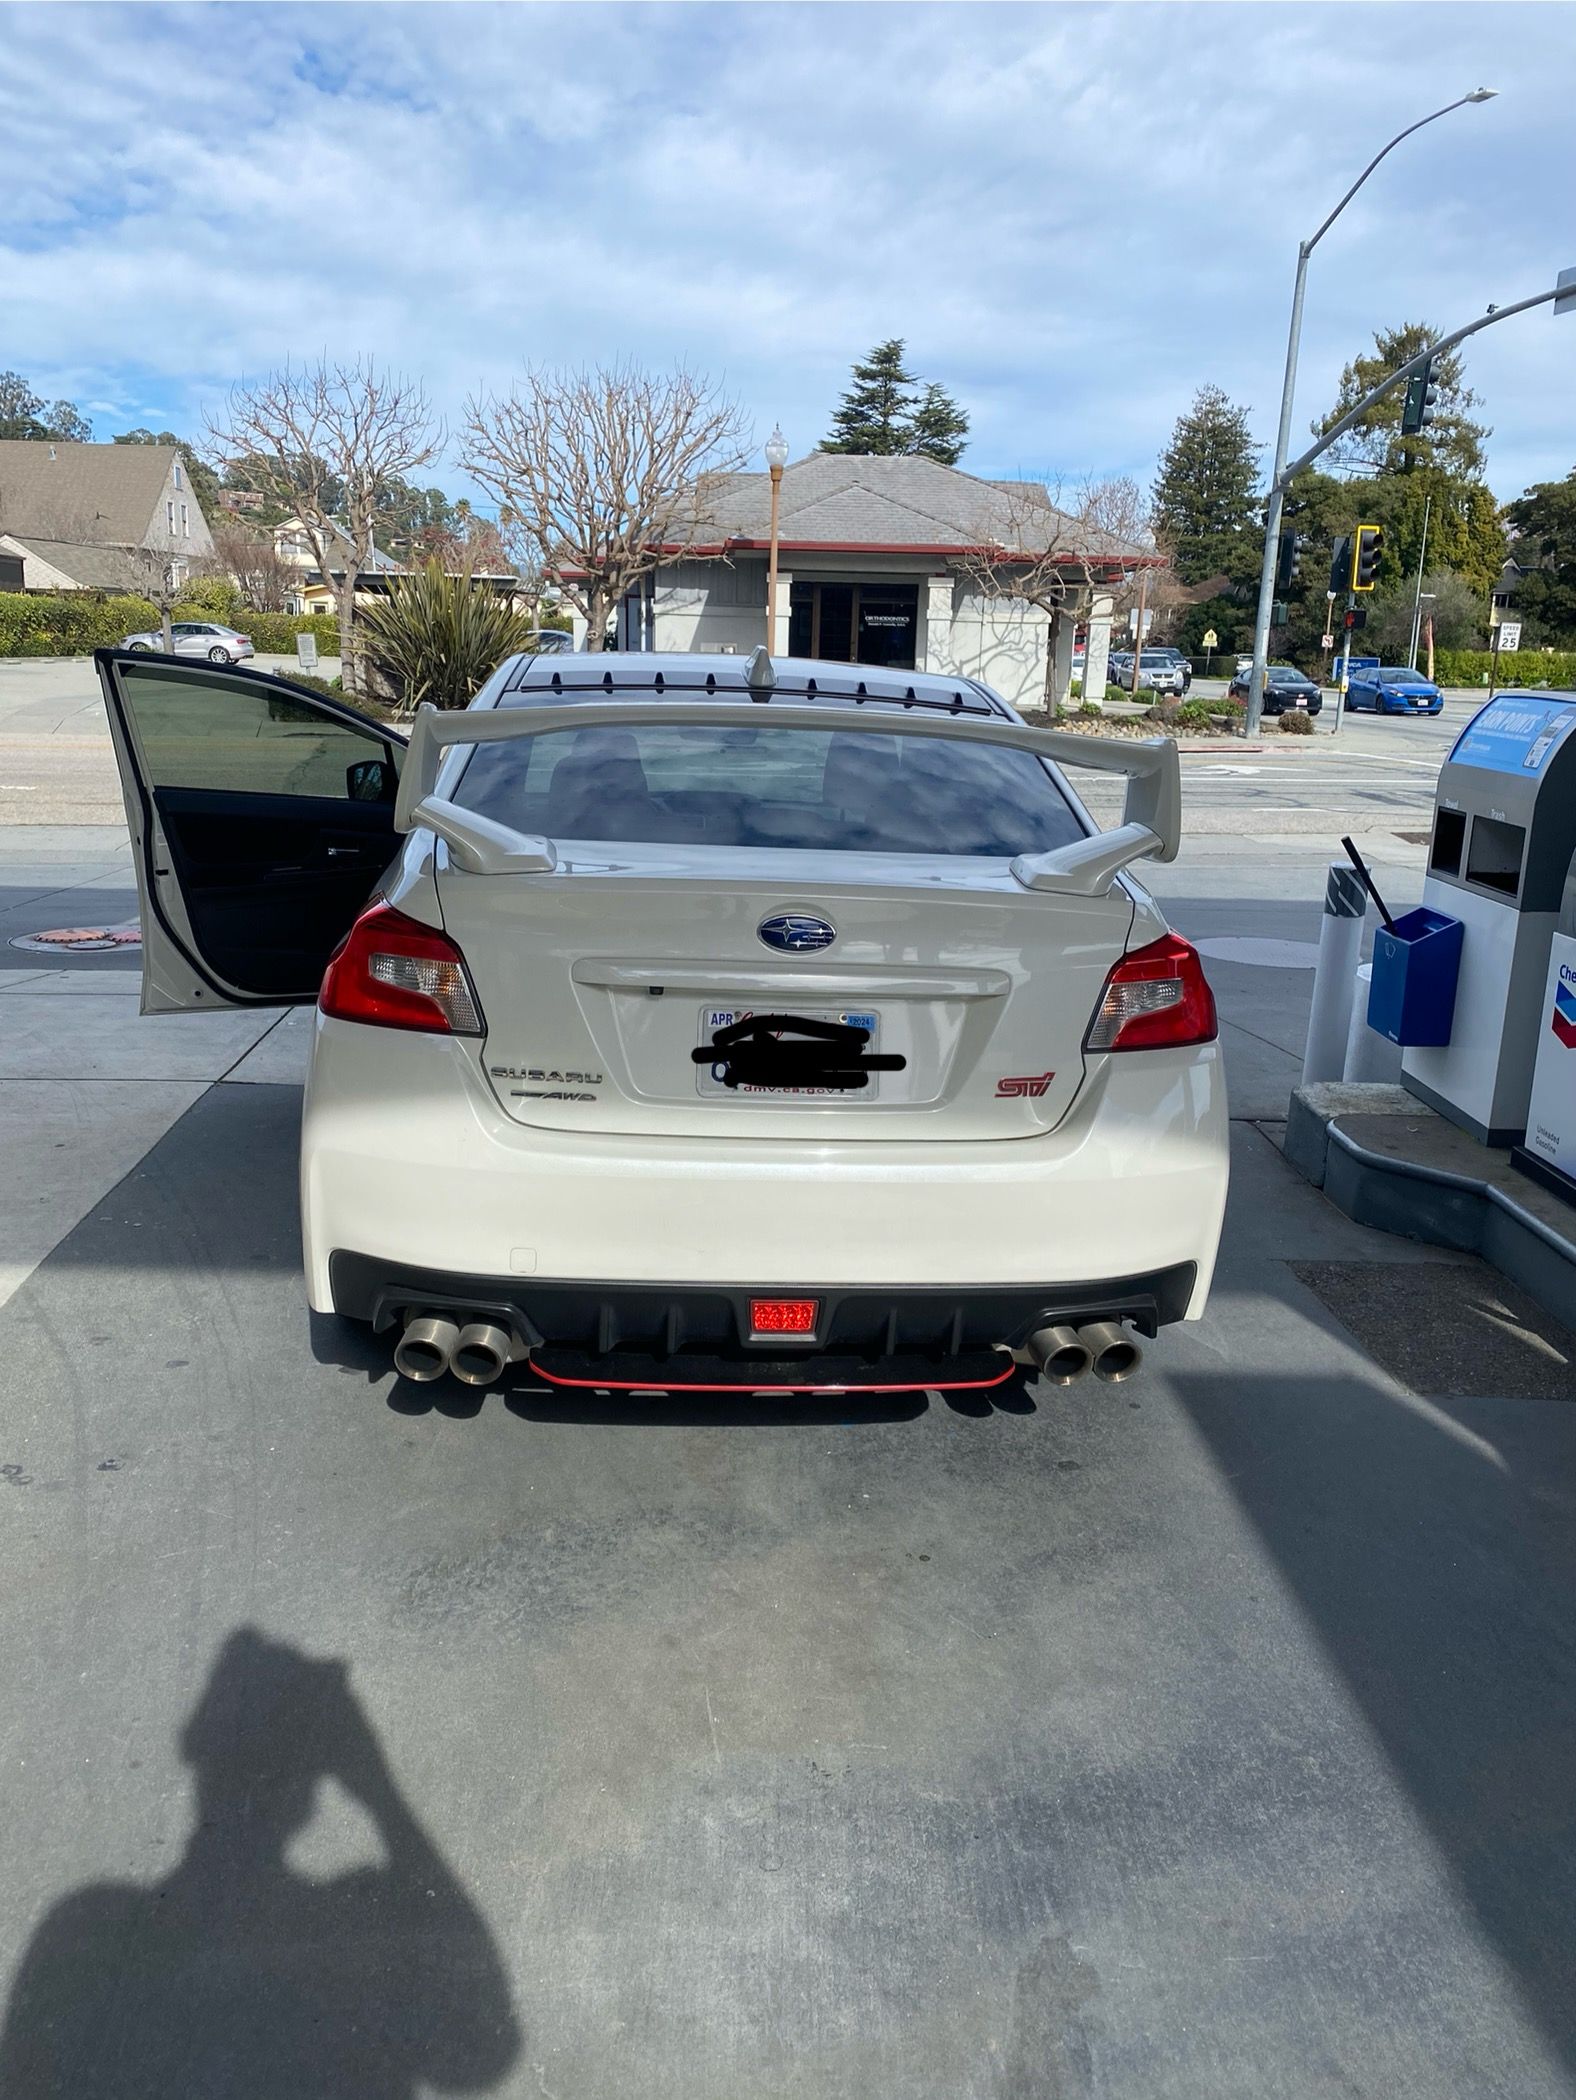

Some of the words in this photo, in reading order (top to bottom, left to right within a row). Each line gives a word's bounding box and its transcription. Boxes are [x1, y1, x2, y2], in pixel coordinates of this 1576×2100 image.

[1502, 638, 1517, 648] 25
[1498, 712, 1543, 734] POINTS
[711, 1013, 733, 1025] APR
[853, 1017, 870, 1026] 2024
[491, 1066, 602, 1084] SUBARU
[743, 1085, 836, 1094] dmv.ca.gov
[1536, 1123, 1560, 1145] Unleaded
[1535, 1135, 1556, 1155] Gasoline
